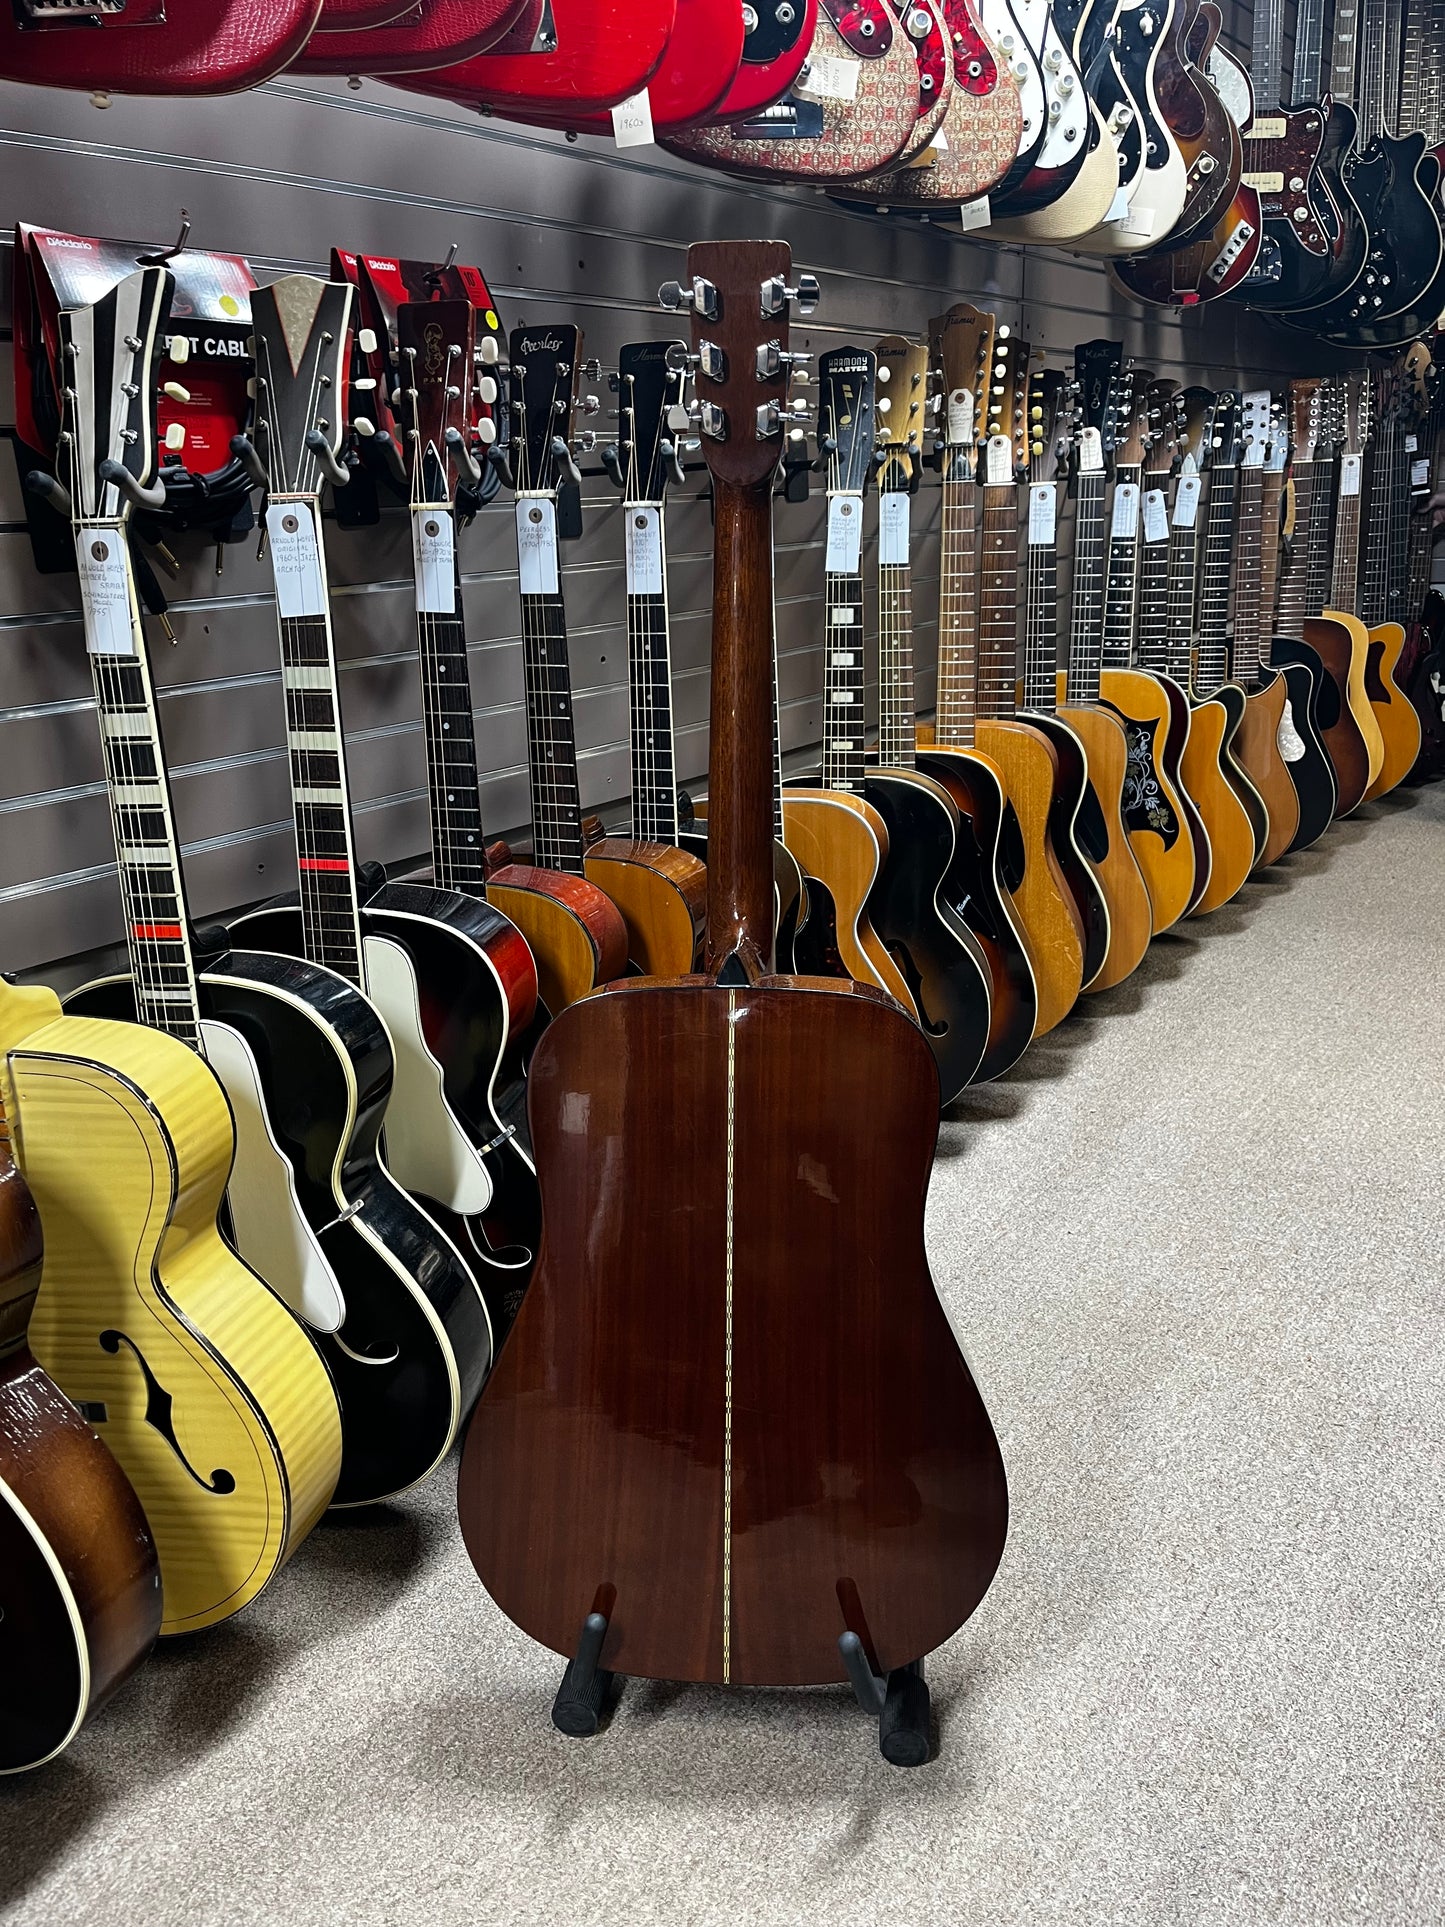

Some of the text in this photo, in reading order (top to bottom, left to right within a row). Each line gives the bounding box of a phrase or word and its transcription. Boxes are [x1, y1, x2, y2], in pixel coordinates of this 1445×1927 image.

[203, 337, 249, 358] CABL
[828, 356, 868, 367] HARMONY
[423, 376, 443, 384] PAN
